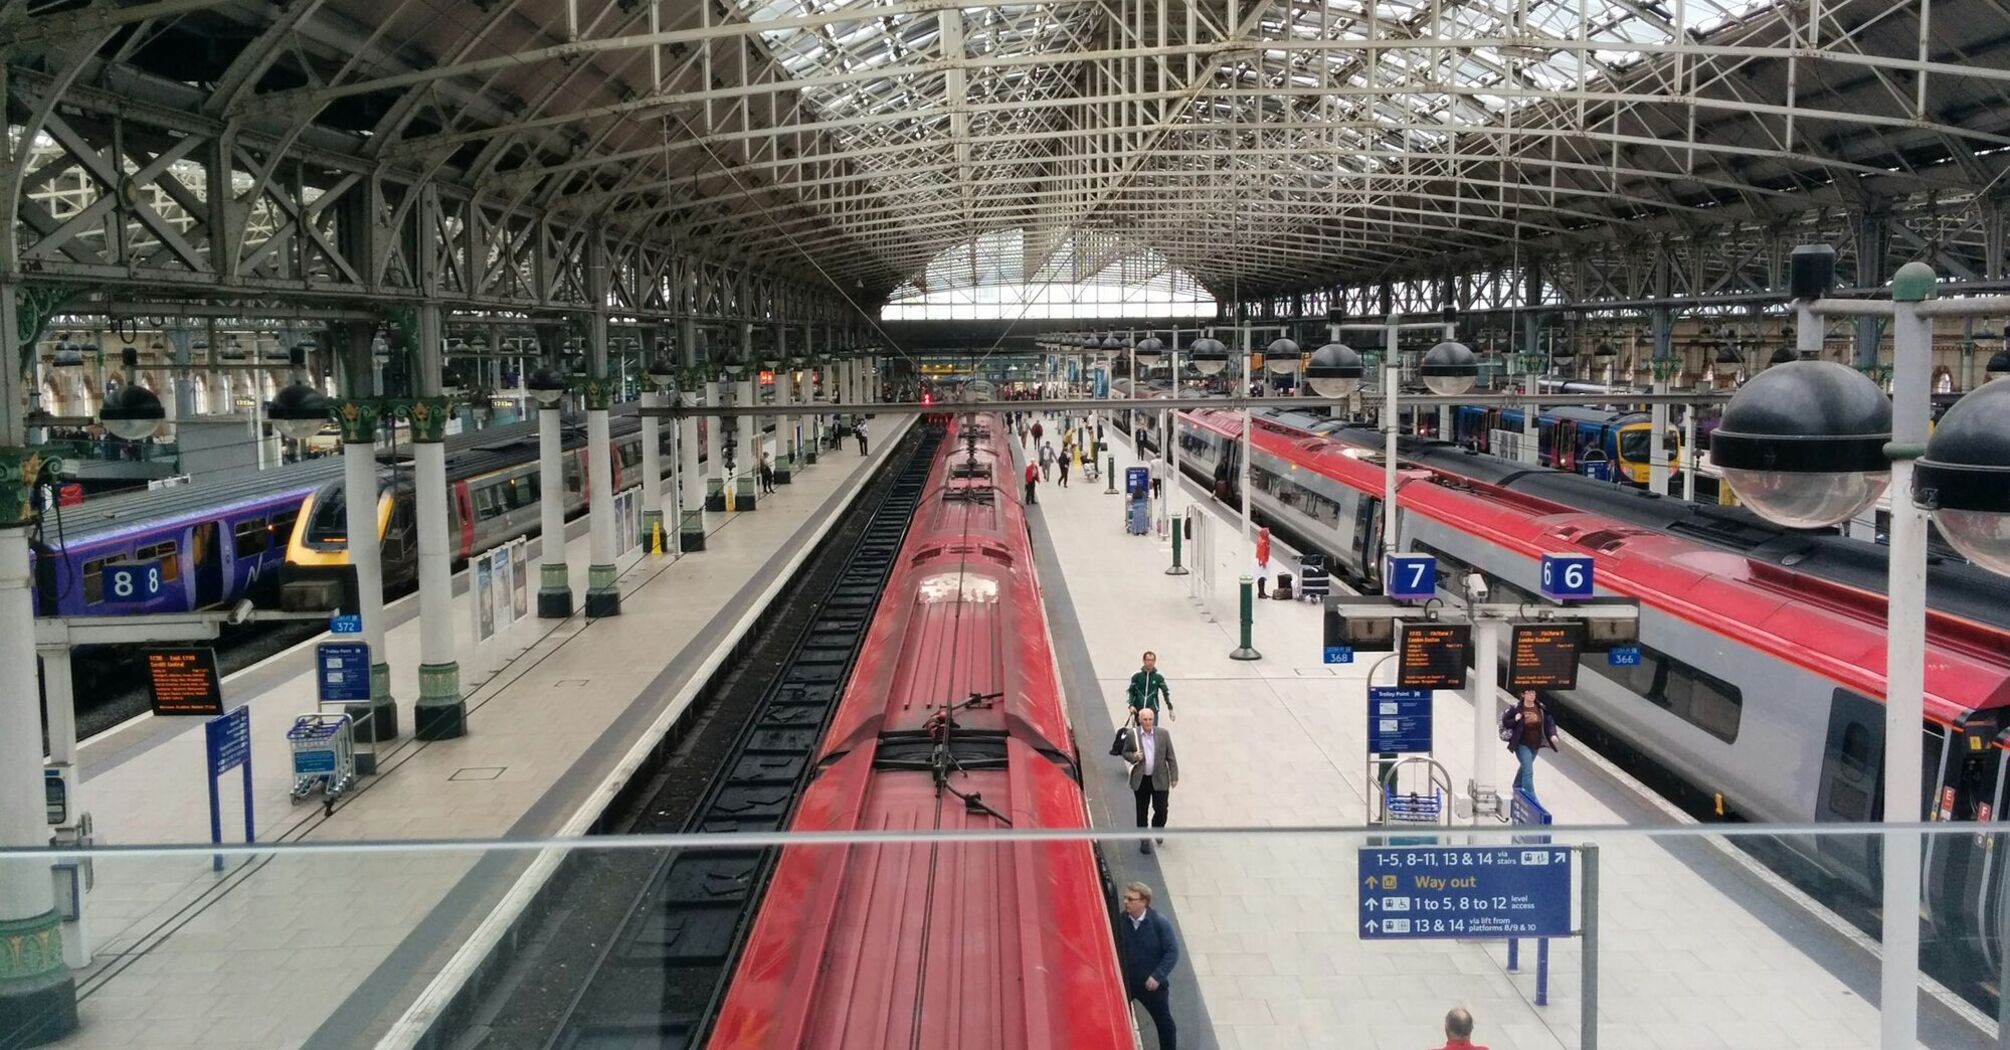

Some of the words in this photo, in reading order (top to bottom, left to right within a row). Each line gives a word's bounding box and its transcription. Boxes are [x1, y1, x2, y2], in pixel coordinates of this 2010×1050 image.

[1408, 563, 1425, 588] 7
[1544, 561, 1551, 585] 6
[1565, 563, 1583, 588] 6
[114, 571, 133, 596] 8
[149, 567, 158, 593] 8
[337, 623, 355, 632] 372
[1330, 654, 1348, 662] 368
[1615, 655, 1633, 663] 366
[1946, 790, 1952, 800] E
[1981, 807, 1987, 816] F
[1377, 854, 1402, 866] 1-5,
[1407, 853, 1438, 866] 8-11,
[1443, 853, 1457, 865] 13
[1461, 853, 1473, 865] &
[1478, 853, 1493, 865] 14
[1416, 876, 1446, 890] Way
[1451, 876, 1476, 887] out
[1415, 897, 1420, 910] 1
[1424, 898, 1439, 910] to
[1443, 897, 1456, 911] 5,
[1459, 897, 1470, 909] 8
[1473, 898, 1488, 909] to
[1492, 897, 1507, 909] 12
[1415, 919, 1430, 932] 13
[1433, 919, 1445, 932] &
[1449, 919, 1464, 932] 14
[1469, 924, 1503, 932] platforms
